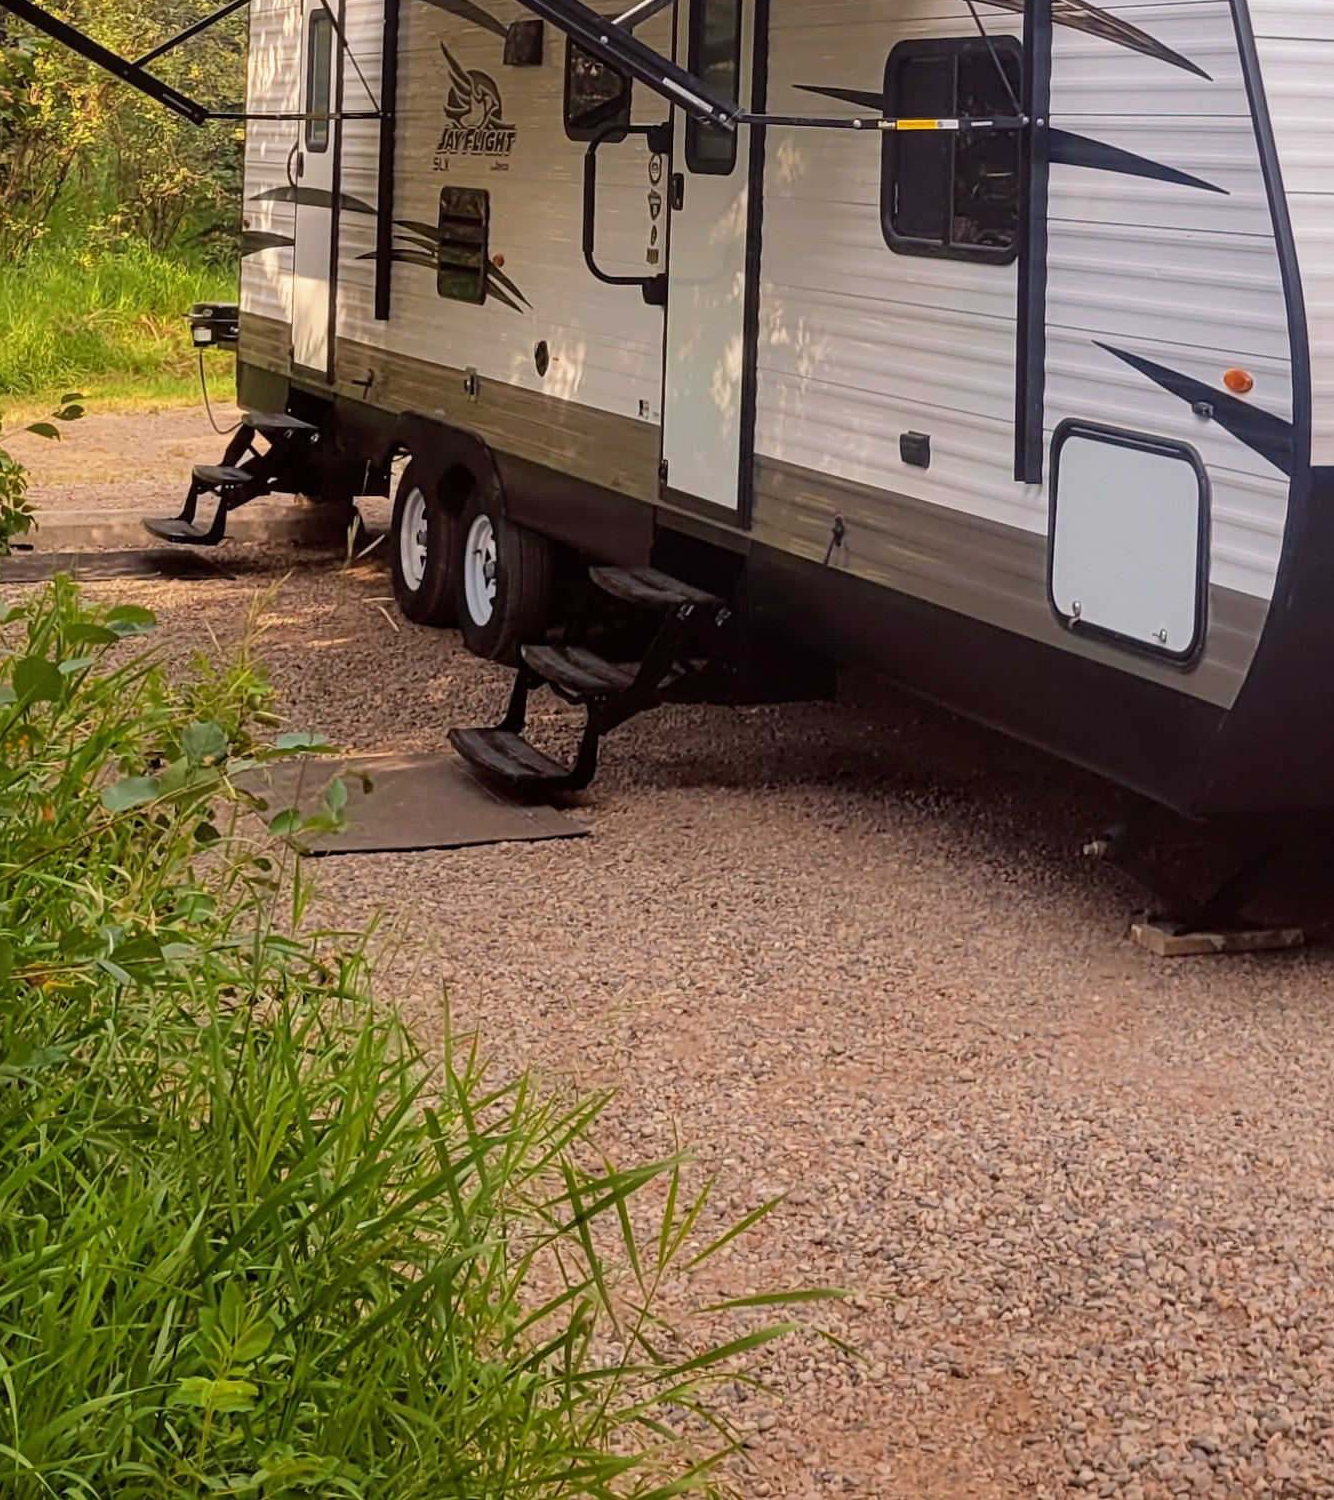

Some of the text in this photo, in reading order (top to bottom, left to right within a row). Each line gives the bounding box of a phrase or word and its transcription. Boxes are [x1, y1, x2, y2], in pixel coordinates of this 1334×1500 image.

[436, 127, 517, 156] JAY FLIGHT
[433, 157, 449, 171] SLX
